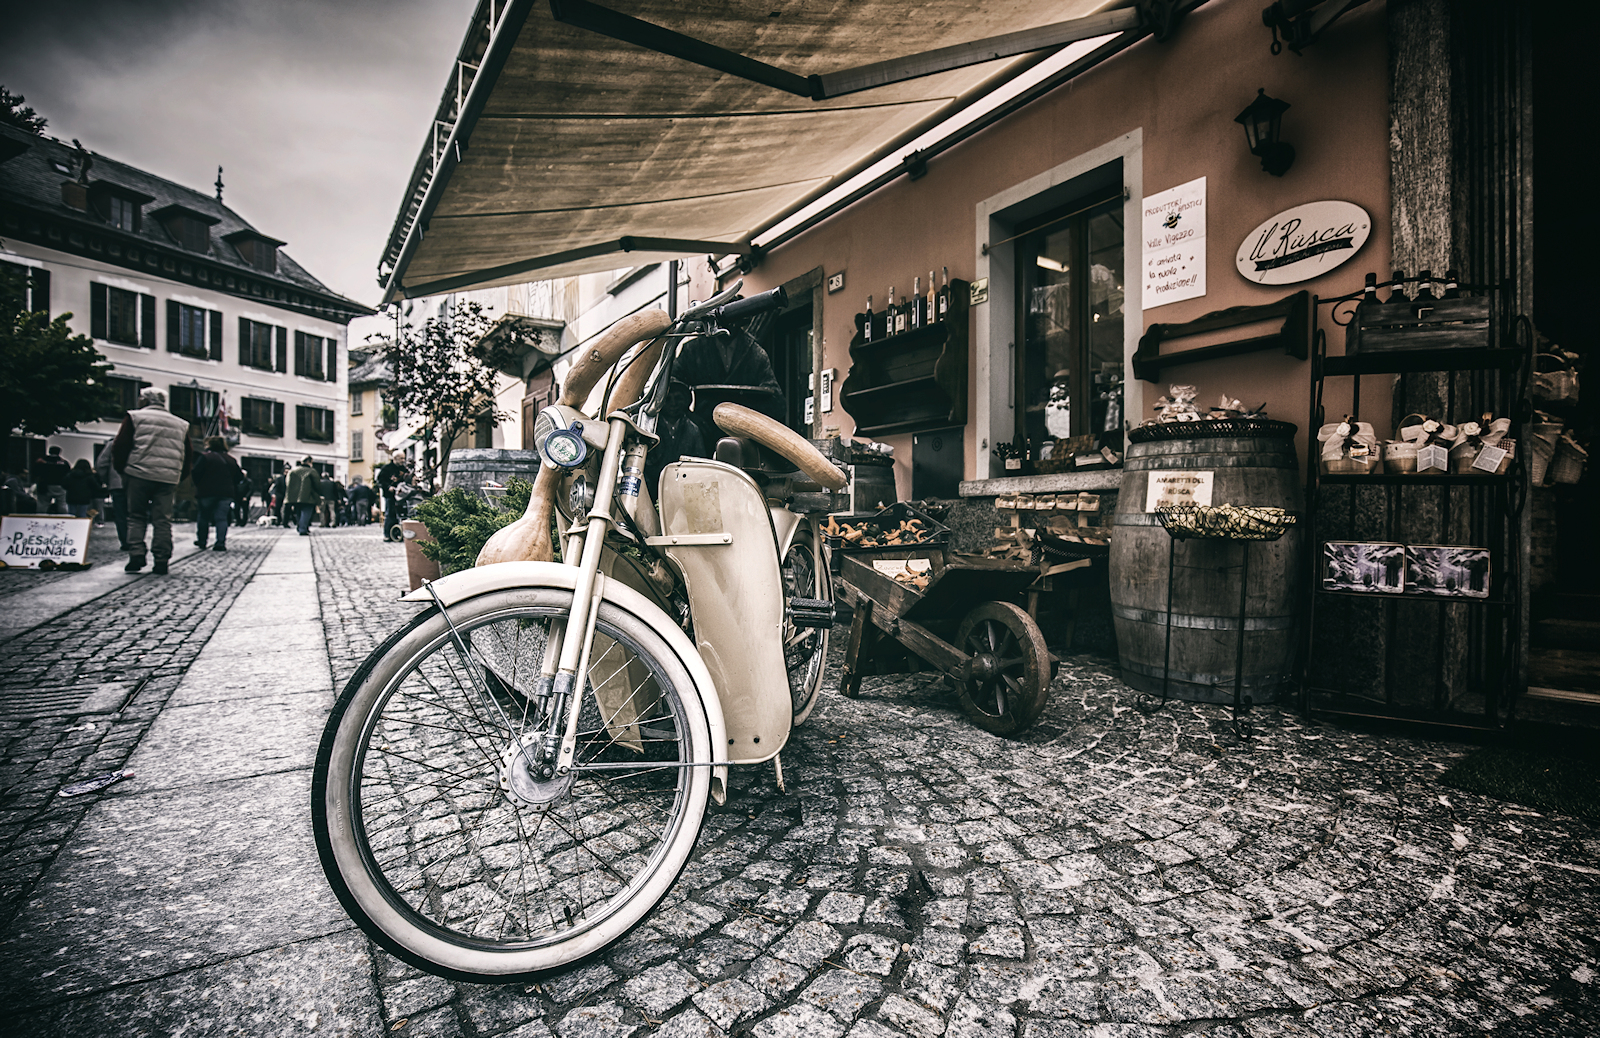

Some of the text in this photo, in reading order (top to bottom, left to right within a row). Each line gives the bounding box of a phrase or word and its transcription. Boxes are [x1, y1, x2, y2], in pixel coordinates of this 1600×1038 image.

[1146, 238, 1163, 249] Valle
[1156, 253, 1181, 266] arrivata
[1149, 266, 1178, 279] la nuova
